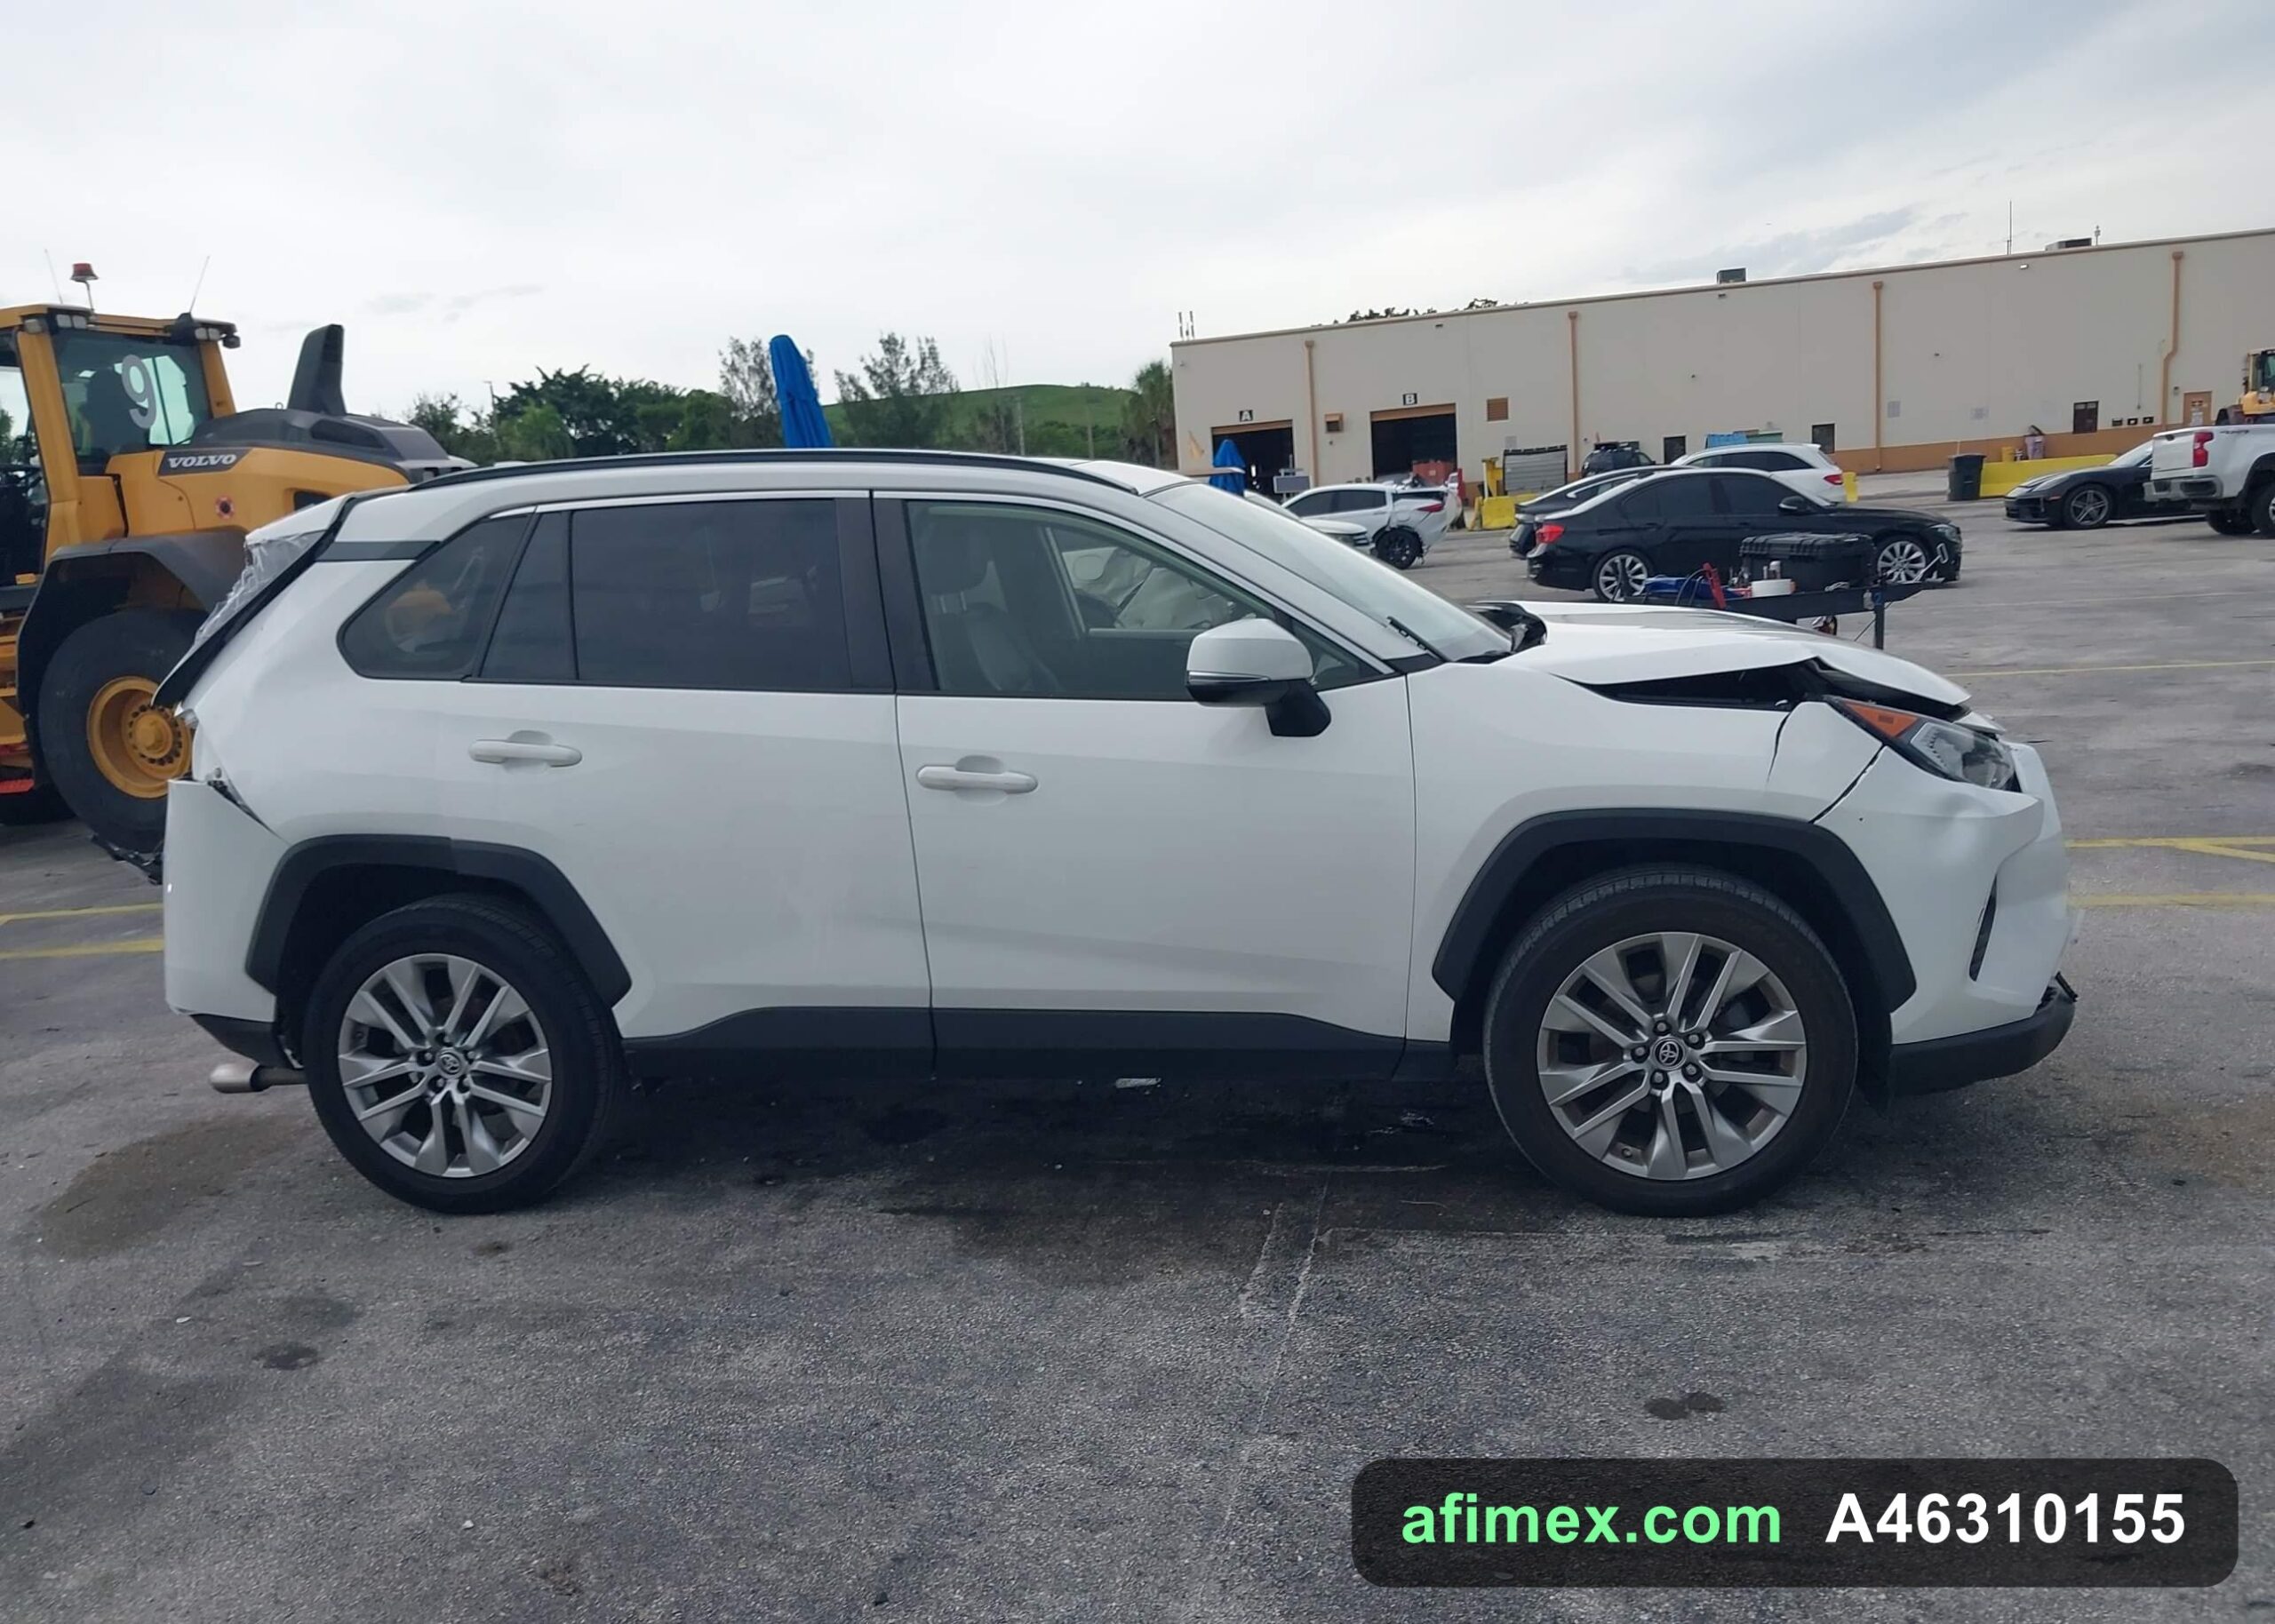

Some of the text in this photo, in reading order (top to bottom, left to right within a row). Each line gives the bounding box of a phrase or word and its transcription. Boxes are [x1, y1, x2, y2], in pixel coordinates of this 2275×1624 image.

[121, 354, 157, 429] 9
[1404, 394, 1416, 405] B
[1241, 410, 1251, 422] A
[168, 454, 237, 469] VOLVO
